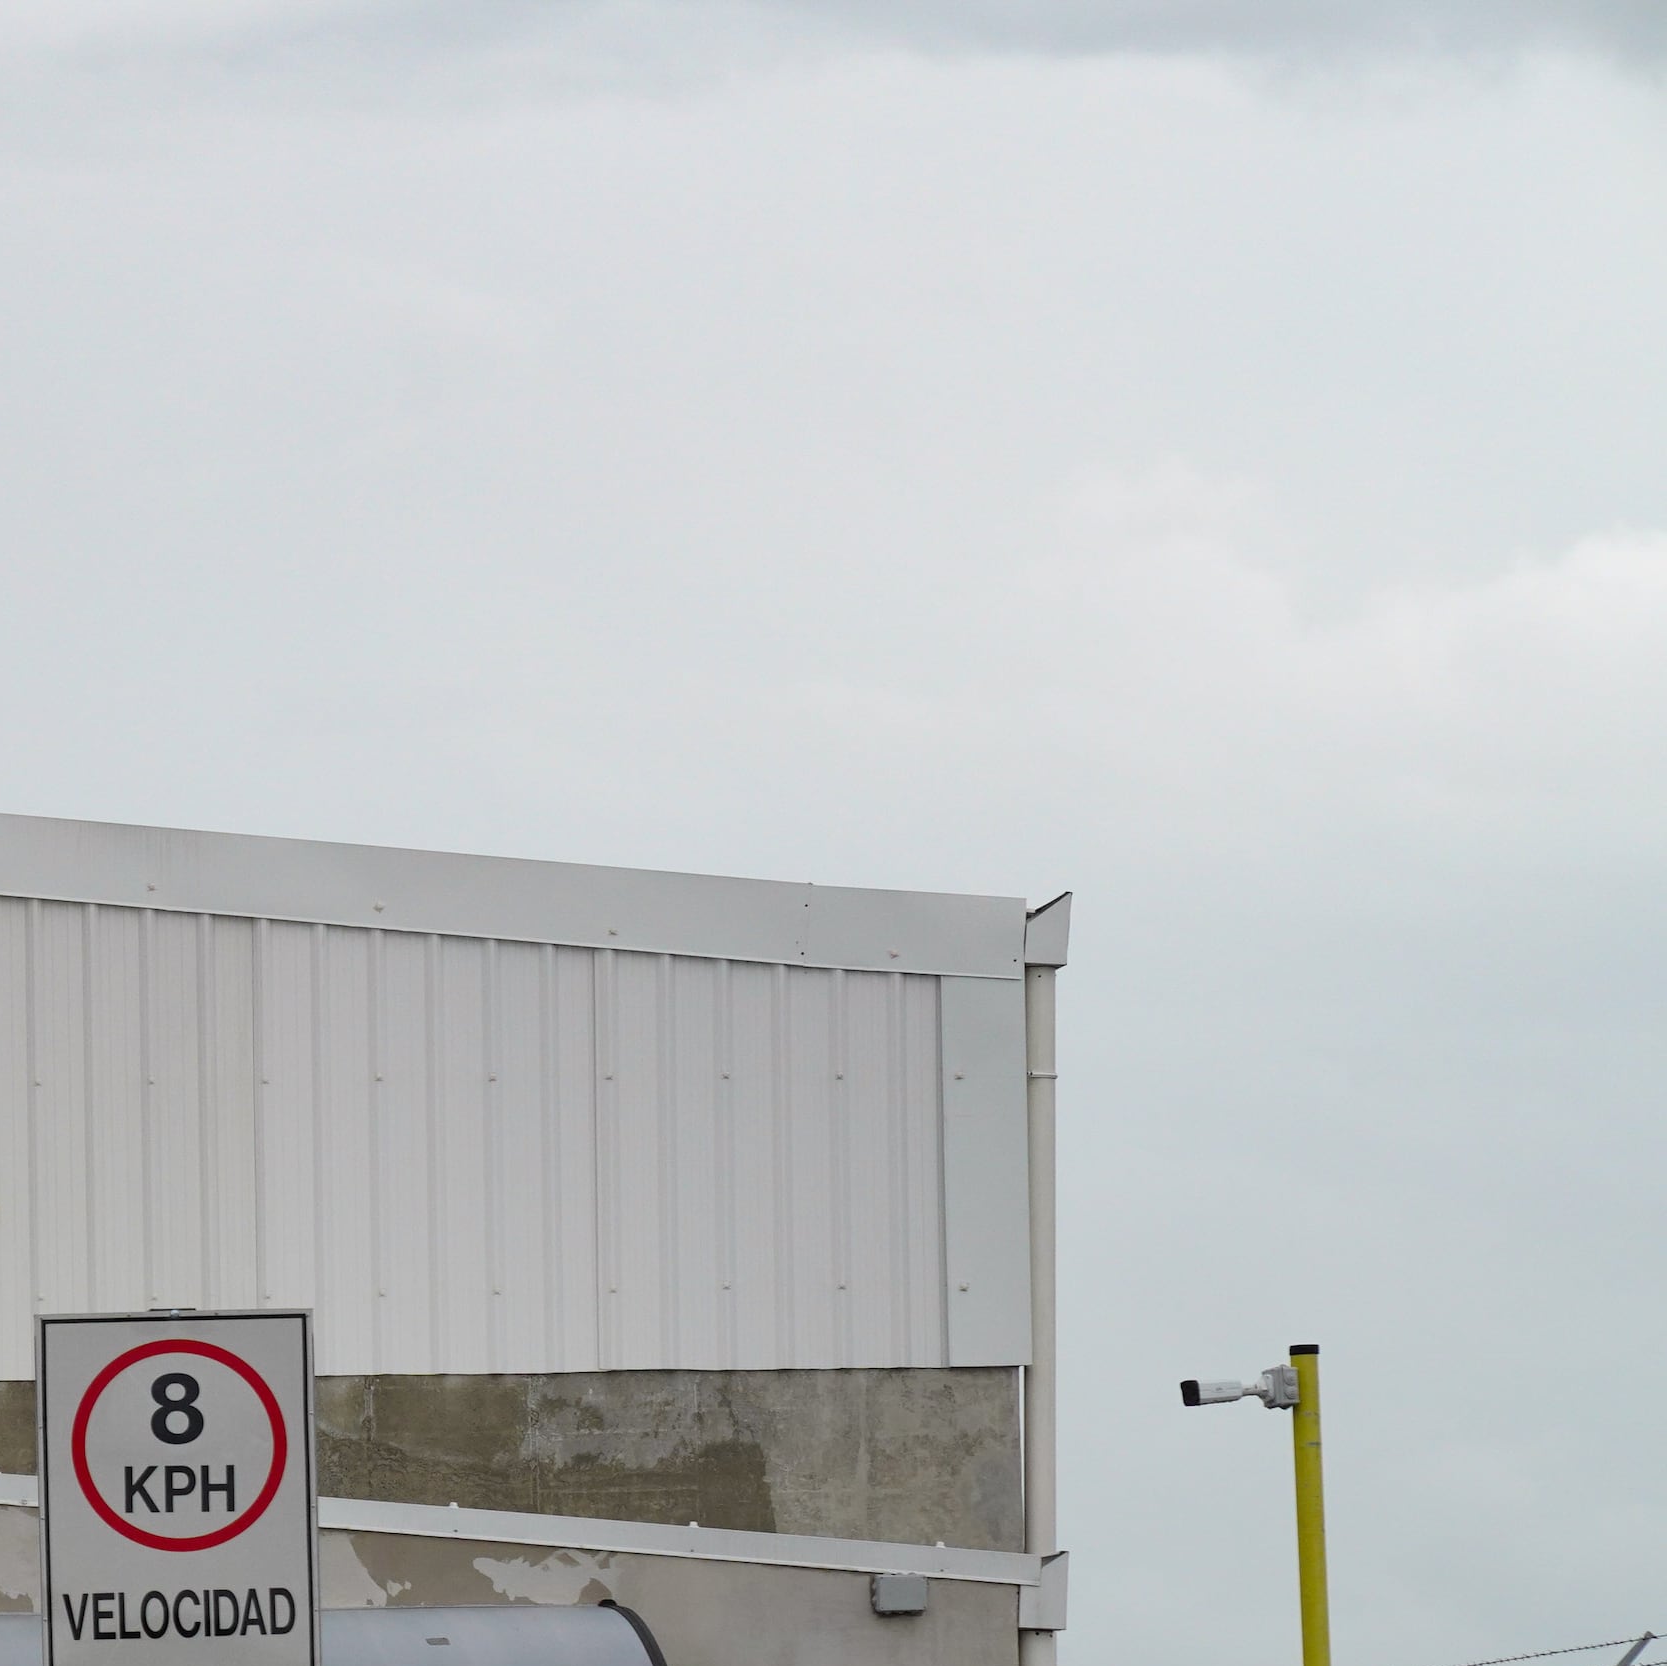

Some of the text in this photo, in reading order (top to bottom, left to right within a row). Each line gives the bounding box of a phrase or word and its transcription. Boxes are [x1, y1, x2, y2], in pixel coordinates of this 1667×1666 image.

[150, 1372, 205, 1445] 8
[124, 1464, 236, 1514] KPH
[62, 1587, 296, 1641] VELOCIDAD
